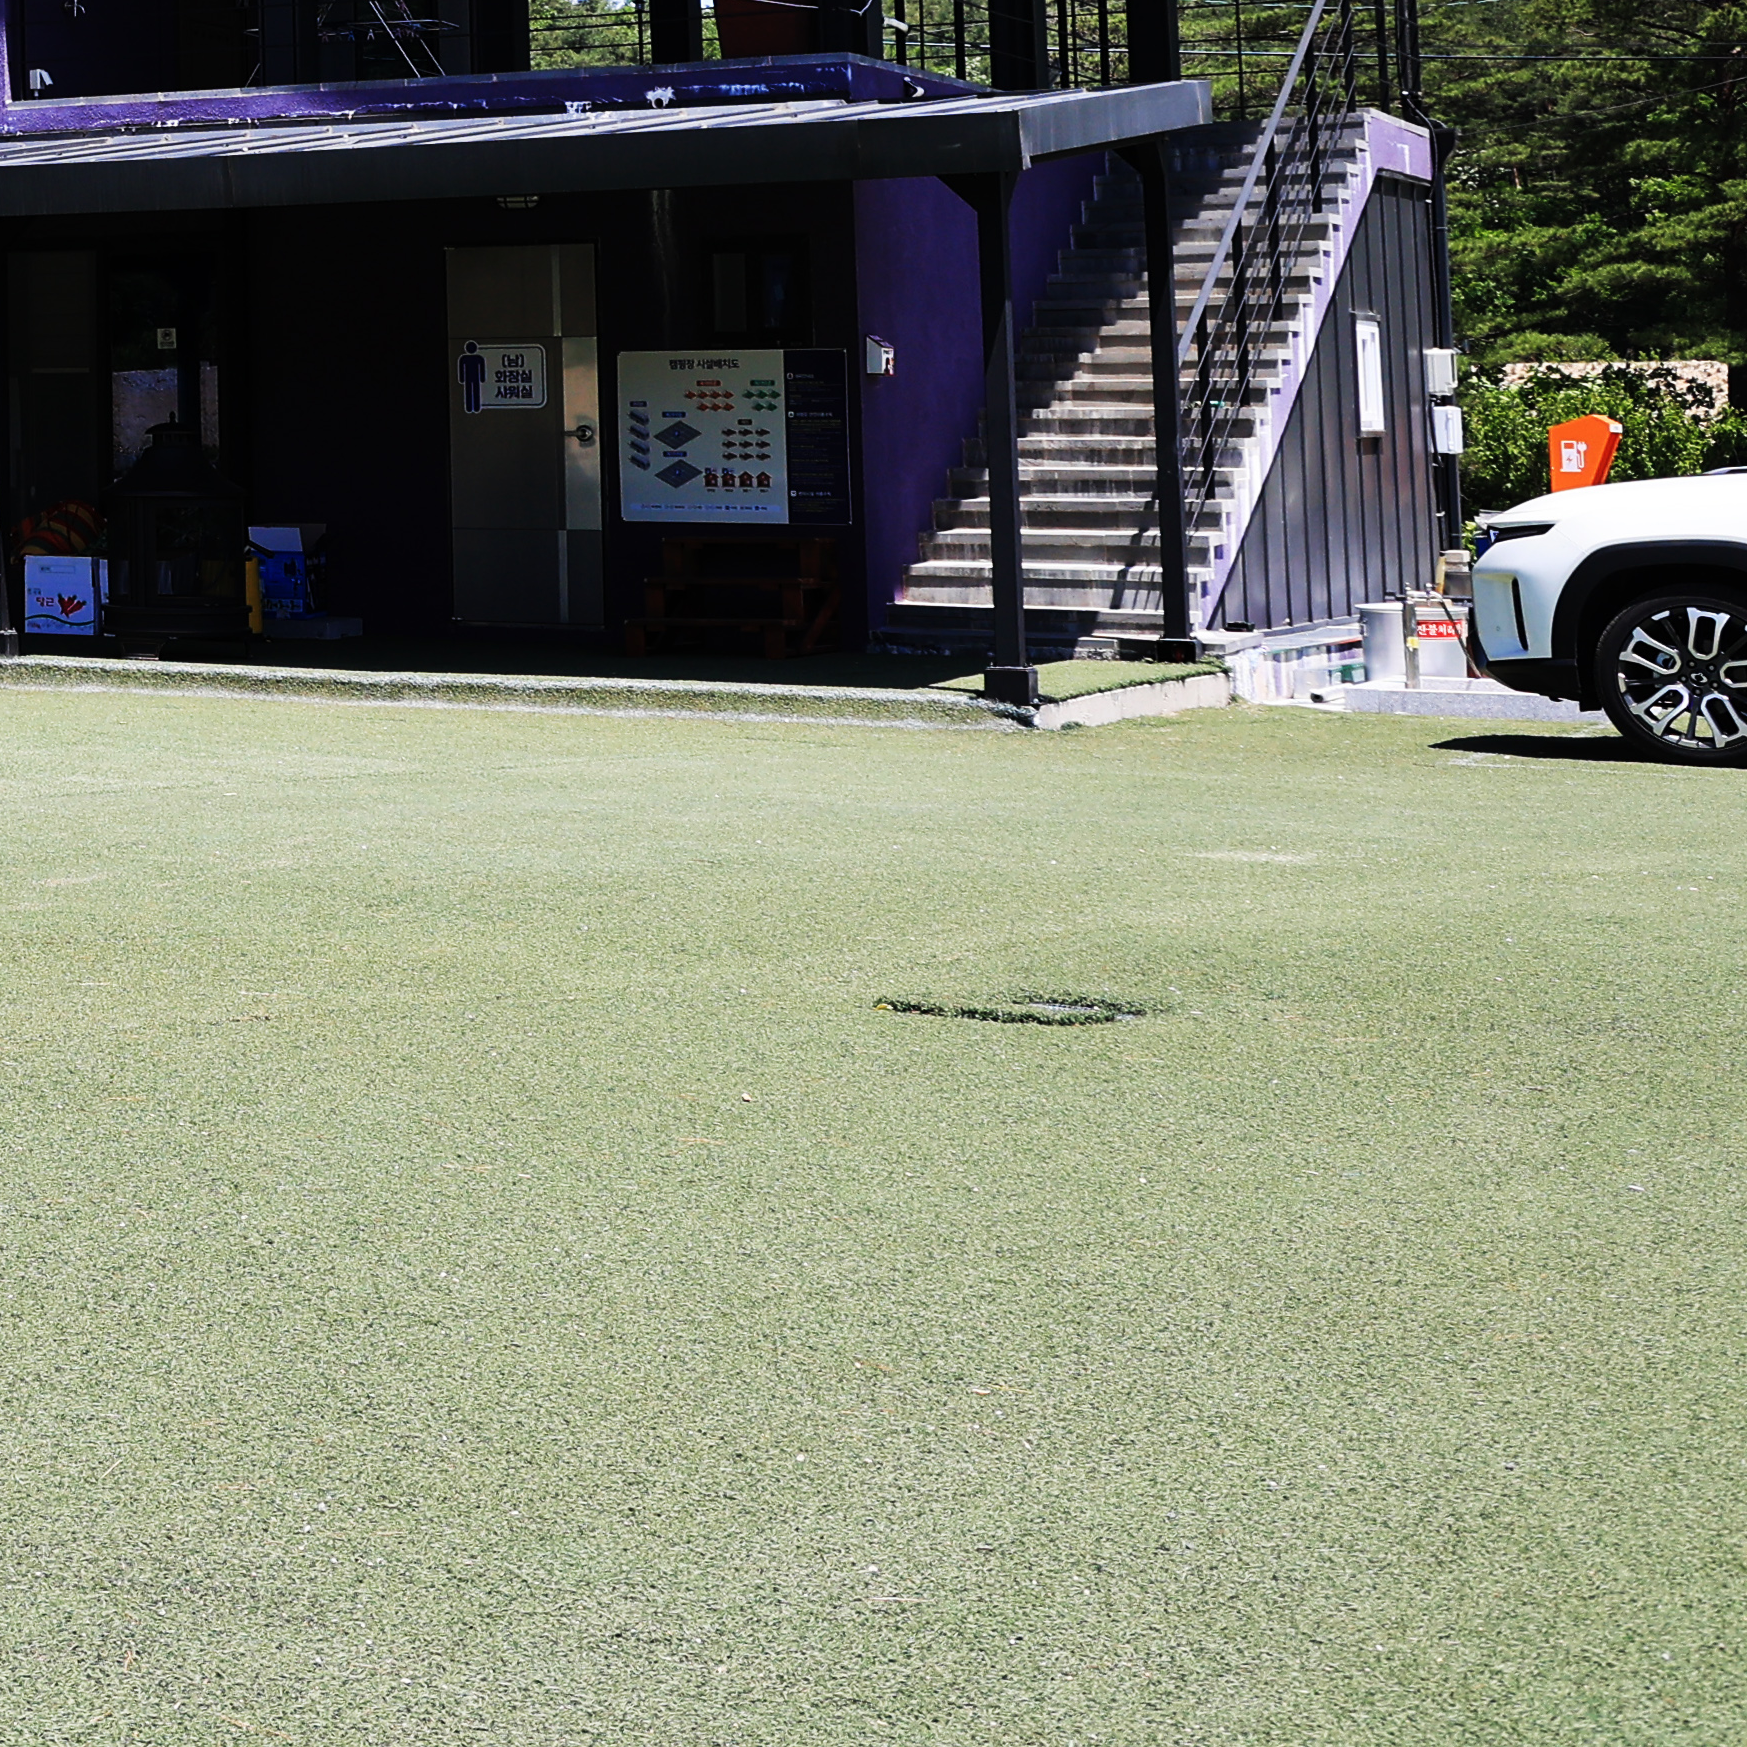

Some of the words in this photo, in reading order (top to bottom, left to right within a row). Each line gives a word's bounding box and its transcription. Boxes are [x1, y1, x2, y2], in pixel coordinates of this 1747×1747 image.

[501, 353, 525, 368] (남)
[494, 369, 532, 384] 화장실
[495, 385, 533, 399] 샤워실
[35, 596, 55, 607] 당근
